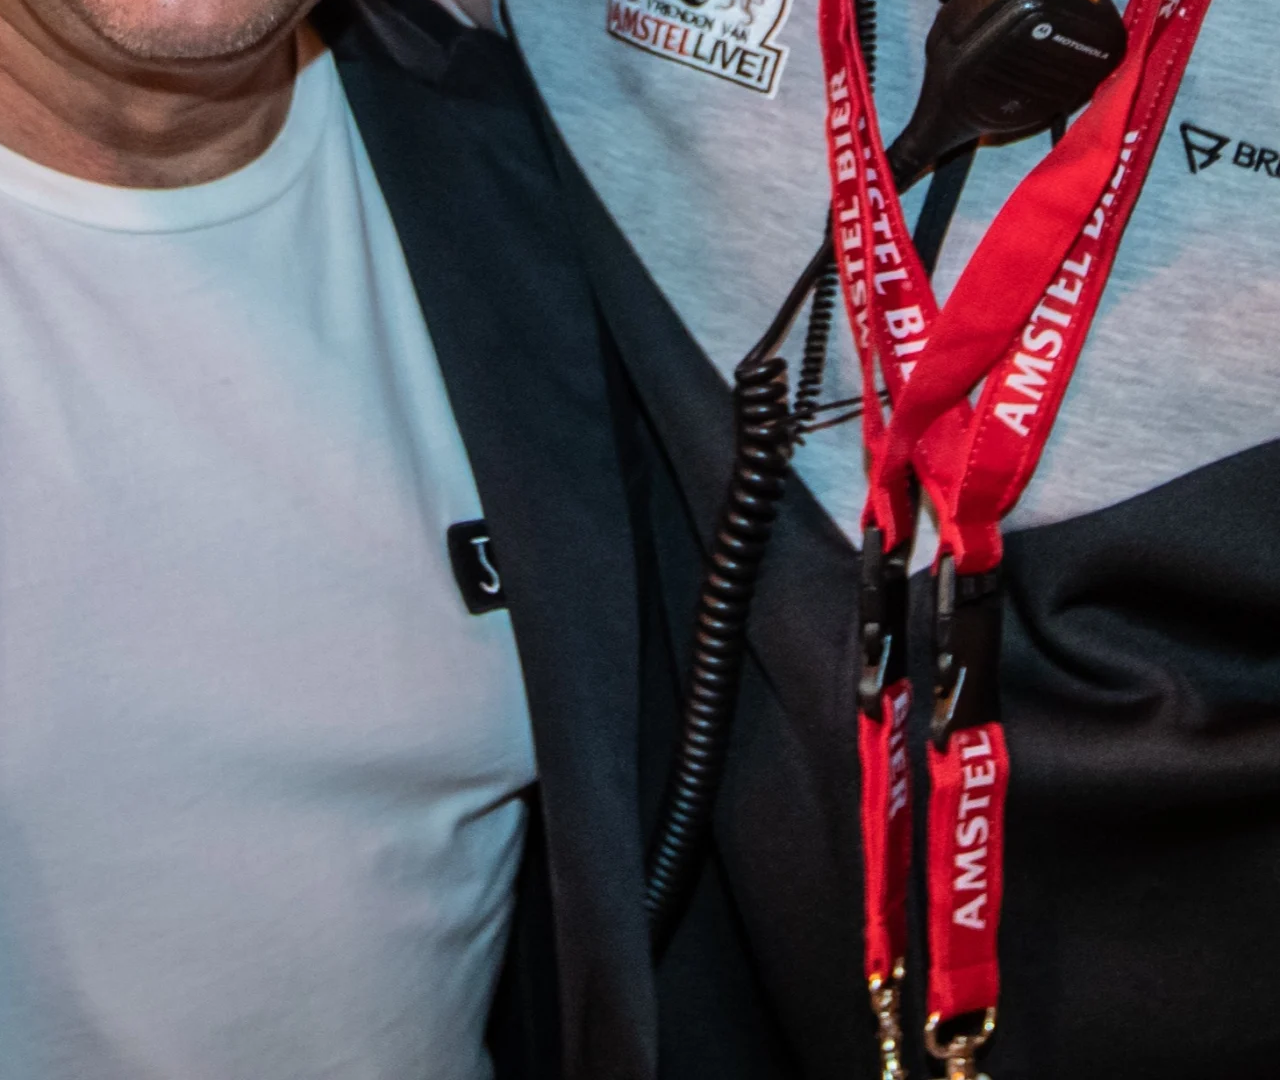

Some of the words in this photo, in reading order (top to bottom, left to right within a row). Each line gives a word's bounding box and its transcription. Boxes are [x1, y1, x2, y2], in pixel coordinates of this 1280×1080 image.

[1052, 34, 1110, 60] MOTOROLA
[832, 67, 857, 183] BIER
[840, 195, 870, 348] MSTEL
[994, 248, 1093, 437] AMSTEL
[952, 729, 996, 931] AMSTEL
